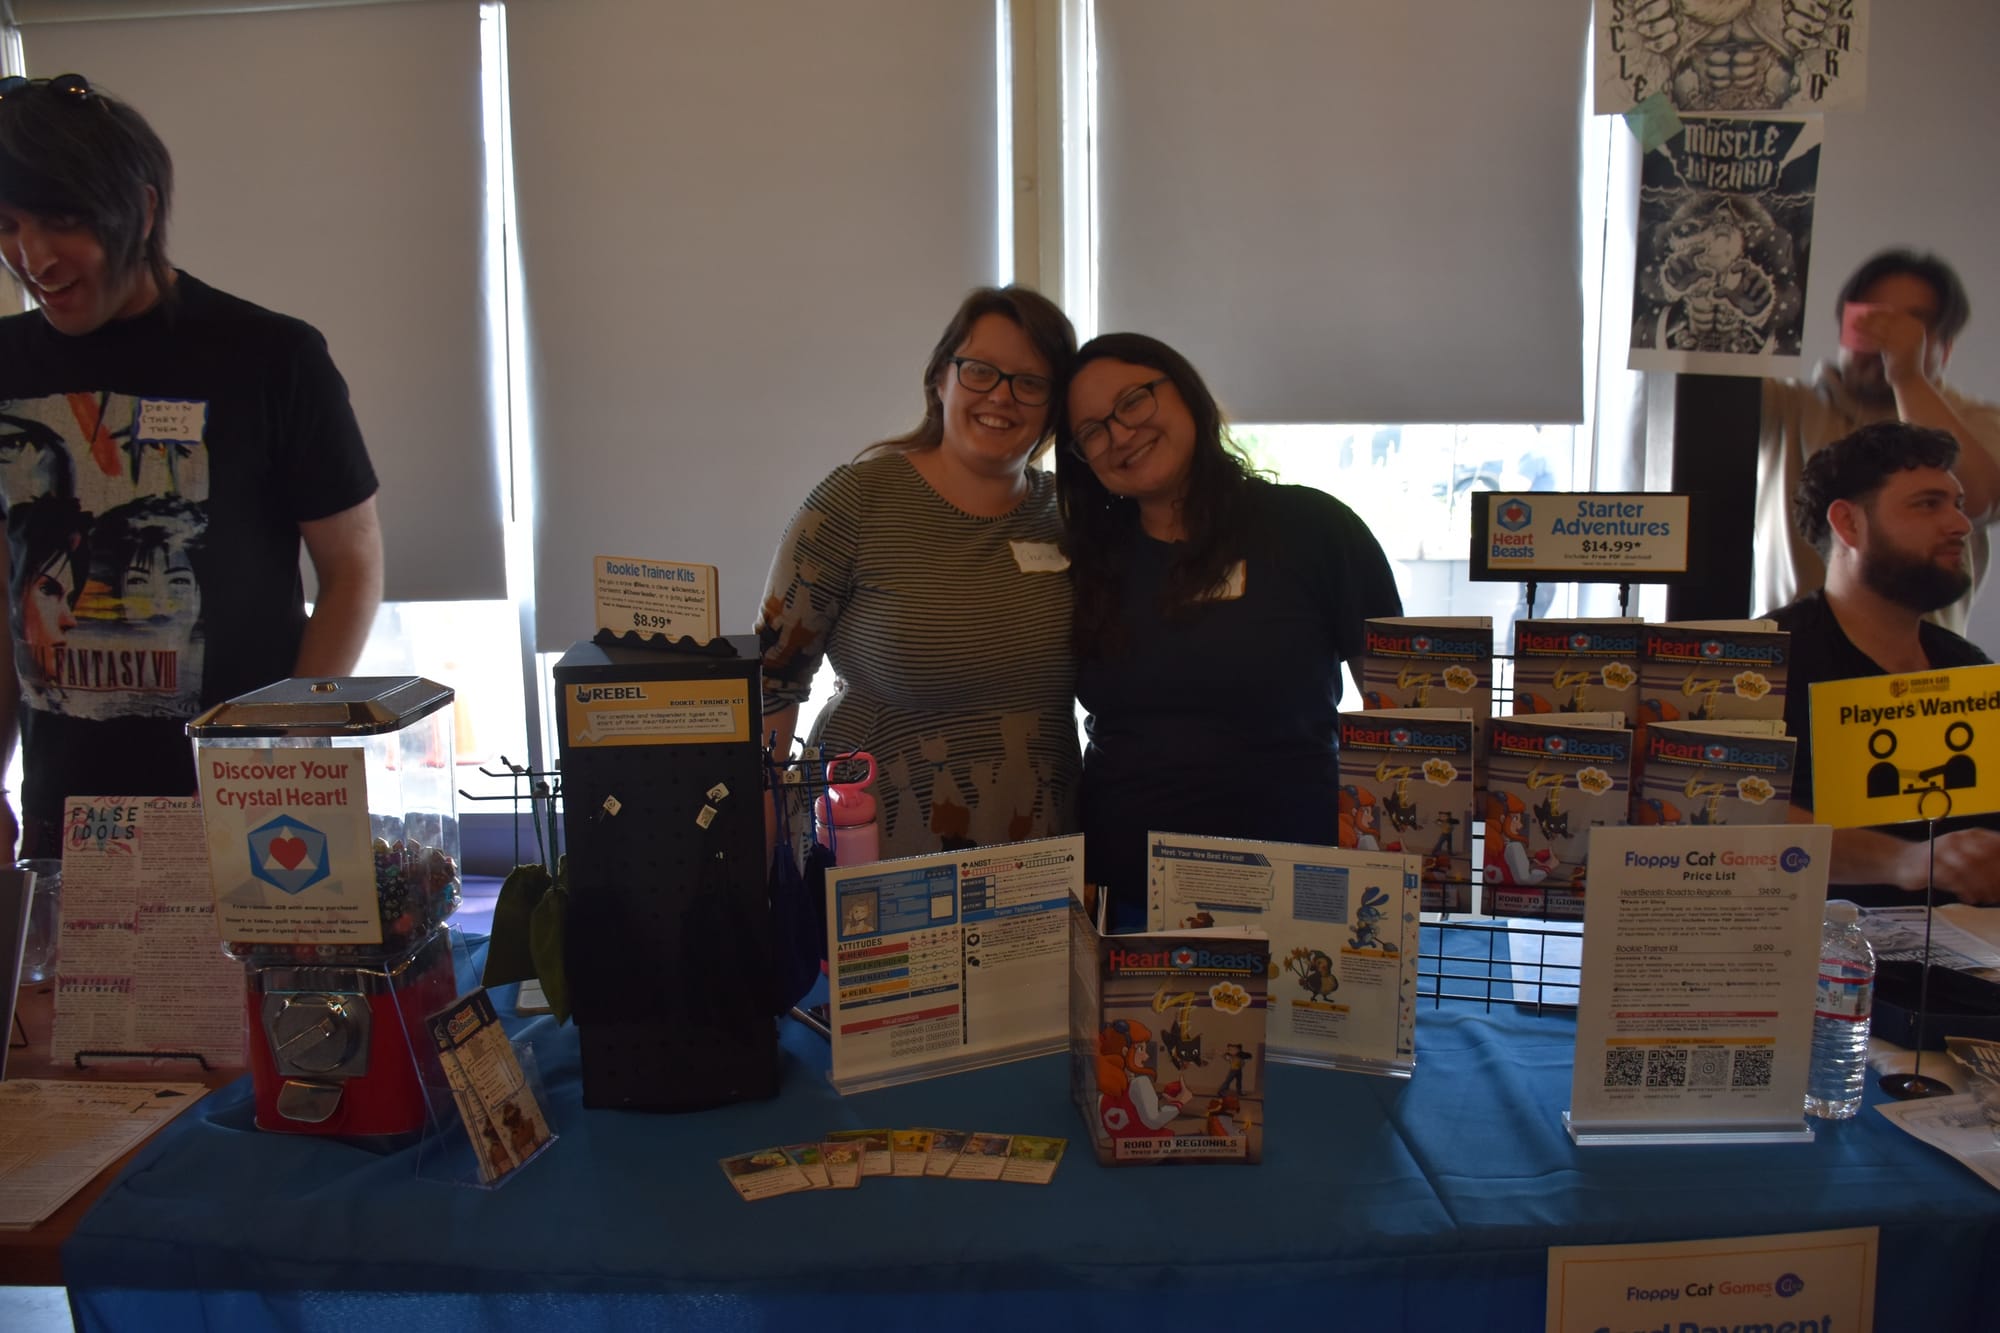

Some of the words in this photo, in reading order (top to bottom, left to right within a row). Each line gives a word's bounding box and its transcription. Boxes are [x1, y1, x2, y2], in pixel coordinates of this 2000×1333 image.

[1684, 123, 1780, 158] MUSCLE
[1686, 158, 1777, 191] WIZARD
[1577, 500, 1644, 518] Starter
[1551, 518, 1670, 536] Adventures
[1493, 533, 1533, 546] Heart
[1491, 545, 1534, 558] Beasts
[606, 561, 640, 577] Rookie
[641, 564, 675, 581] Trainer
[677, 568, 696, 583] Kits
[1366, 631, 1411, 652] Heart
[1432, 639, 1487, 657] Beasts
[1519, 630, 1568, 652] Heart
[1591, 632, 1638, 653] Beast
[1648, 636, 1699, 658] Heart
[1725, 642, 1784, 664] Beasts
[55, 647, 146, 688] FANTASY
[592, 687, 646, 700] REBEL
[1840, 704, 1916, 726] Players
[1919, 691, 2000, 716] Wanted
[1342, 723, 1389, 745] Heart
[1411, 732, 1467, 752] Beasts
[1493, 728, 1545, 749] Heart
[1567, 739, 1625, 761] Beasts
[1650, 735, 1704, 758] Heart
[1727, 748, 1788, 770] Beasts
[213, 761, 297, 779] Discover
[301, 761, 349, 779] Your
[216, 788, 282, 809] Crystal
[287, 788, 349, 806] Heart!
[71, 807, 138, 822] FALSE
[72, 825, 136, 840] IDOLS
[969, 858, 991, 867] ANGST
[1625, 851, 1680, 869] Floppy
[1686, 851, 1716, 866] Cat
[1720, 850, 1777, 866] Games
[1683, 871, 1712, 881] Price
[1715, 871, 1736, 881] List
[838, 937, 883, 951] ATTITUDES
[1616, 944, 1644, 952] Rookie
[1644, 944, 1668, 952] Trainer
[1669, 944, 1678, 952] Kit
[1108, 948, 1170, 971] Heart
[1196, 949, 1264, 973] Beasts
[1124, 1140, 1152, 1149] ROAD
[1159, 1140, 1171, 1148] TO
[1176, 1139, 1238, 1148] REGIONALS
[1627, 1286, 1680, 1302] Floppy
[1685, 1282, 1714, 1298] Cat
[1719, 1280, 1773, 1297] Games
